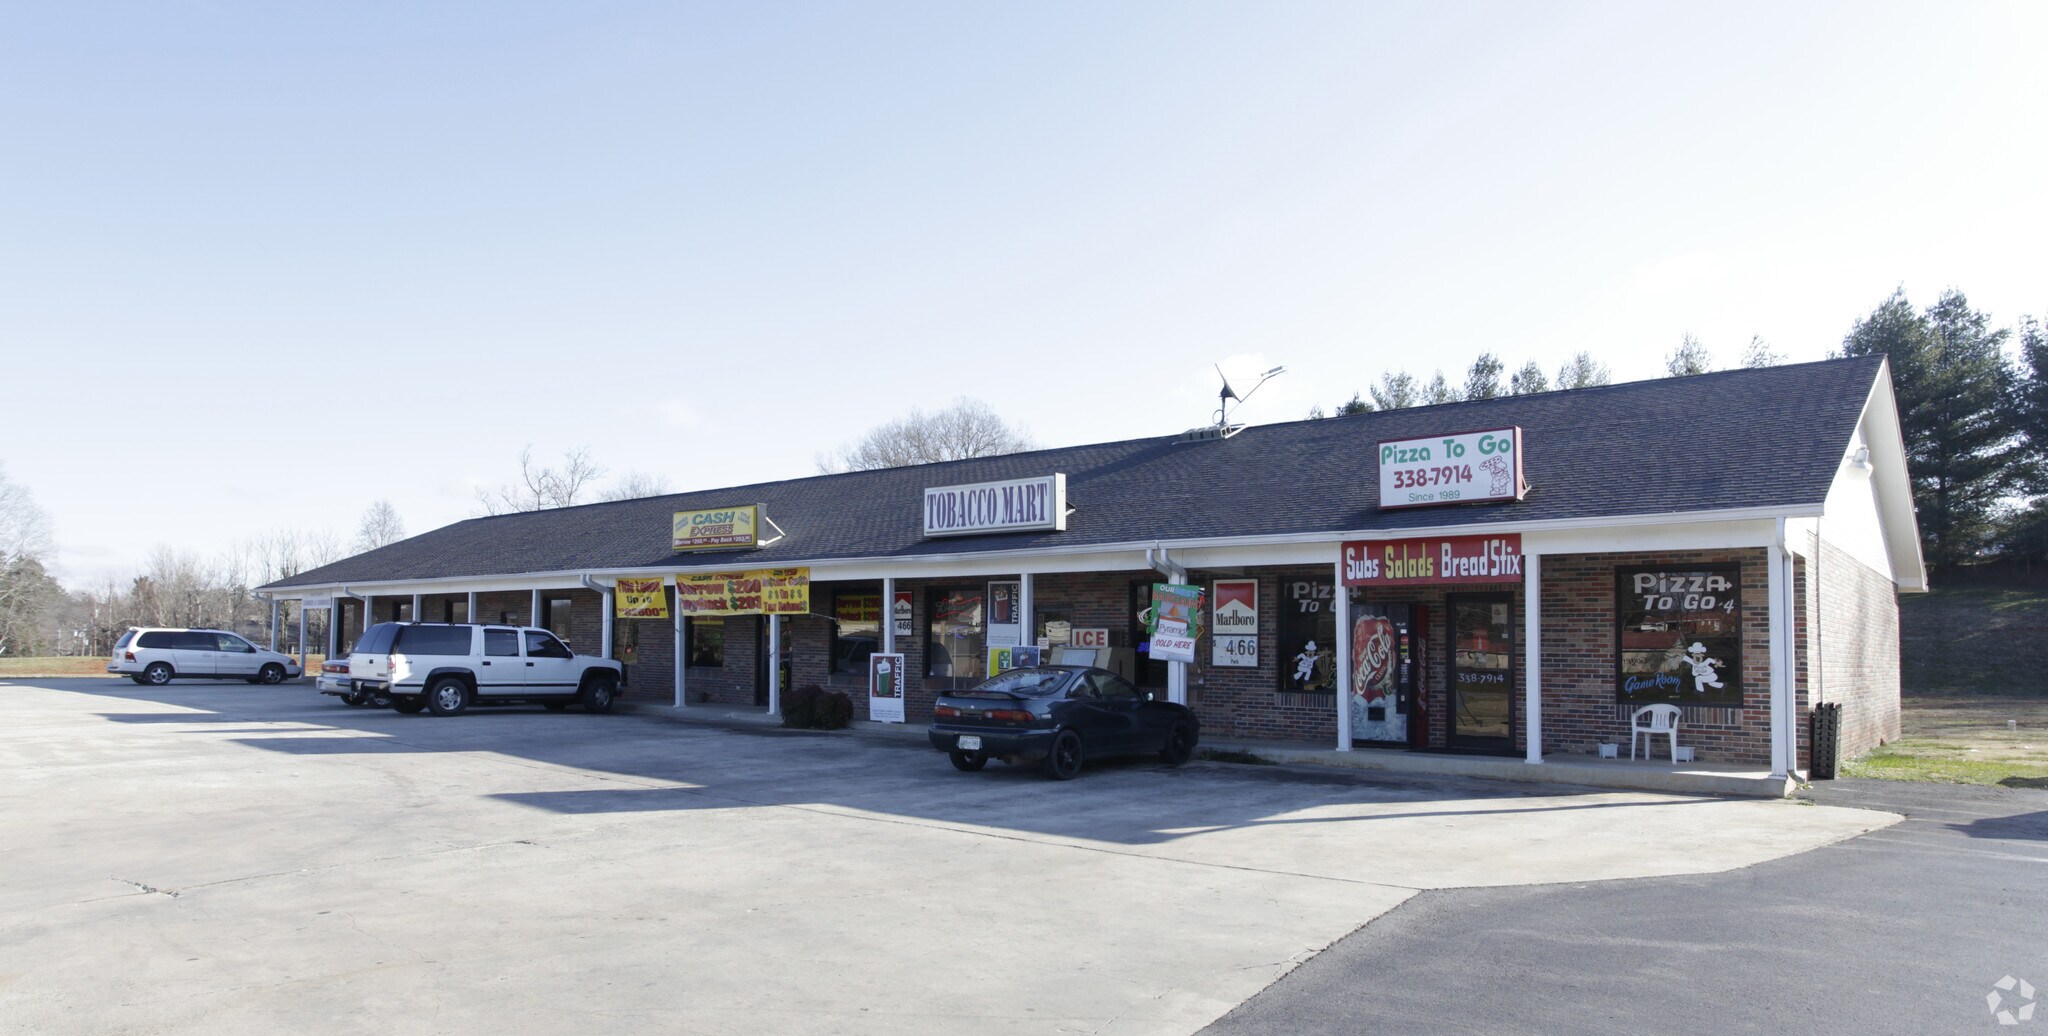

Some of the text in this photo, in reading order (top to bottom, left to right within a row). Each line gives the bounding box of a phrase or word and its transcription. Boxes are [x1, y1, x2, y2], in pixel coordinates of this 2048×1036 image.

[1381, 435, 1511, 465] Pizza To Go
[1393, 464, 1473, 489] 338-7914
[1408, 490, 1460, 502] Since 1989
[926, 483, 1048, 530] TOBACCO MART
[691, 511, 736, 526] CASH
[689, 524, 734, 537] EXPRESS
[1346, 546, 1379, 580] Subs
[1384, 542, 1434, 580] Salads
[1160, 585, 1175, 593] OUR
[627, 596, 638, 604] Up
[1216, 609, 1255, 626] Marlboro
[1159, 624, 1186, 635] Pyramid
[1075, 631, 1105, 646] ICE
[1154, 639, 1172, 647] SOLD
[1173, 641, 1192, 649] HERE
[1458, 673, 1504, 684] 338-7914
[1624, 672, 1681, 693] Game Room
